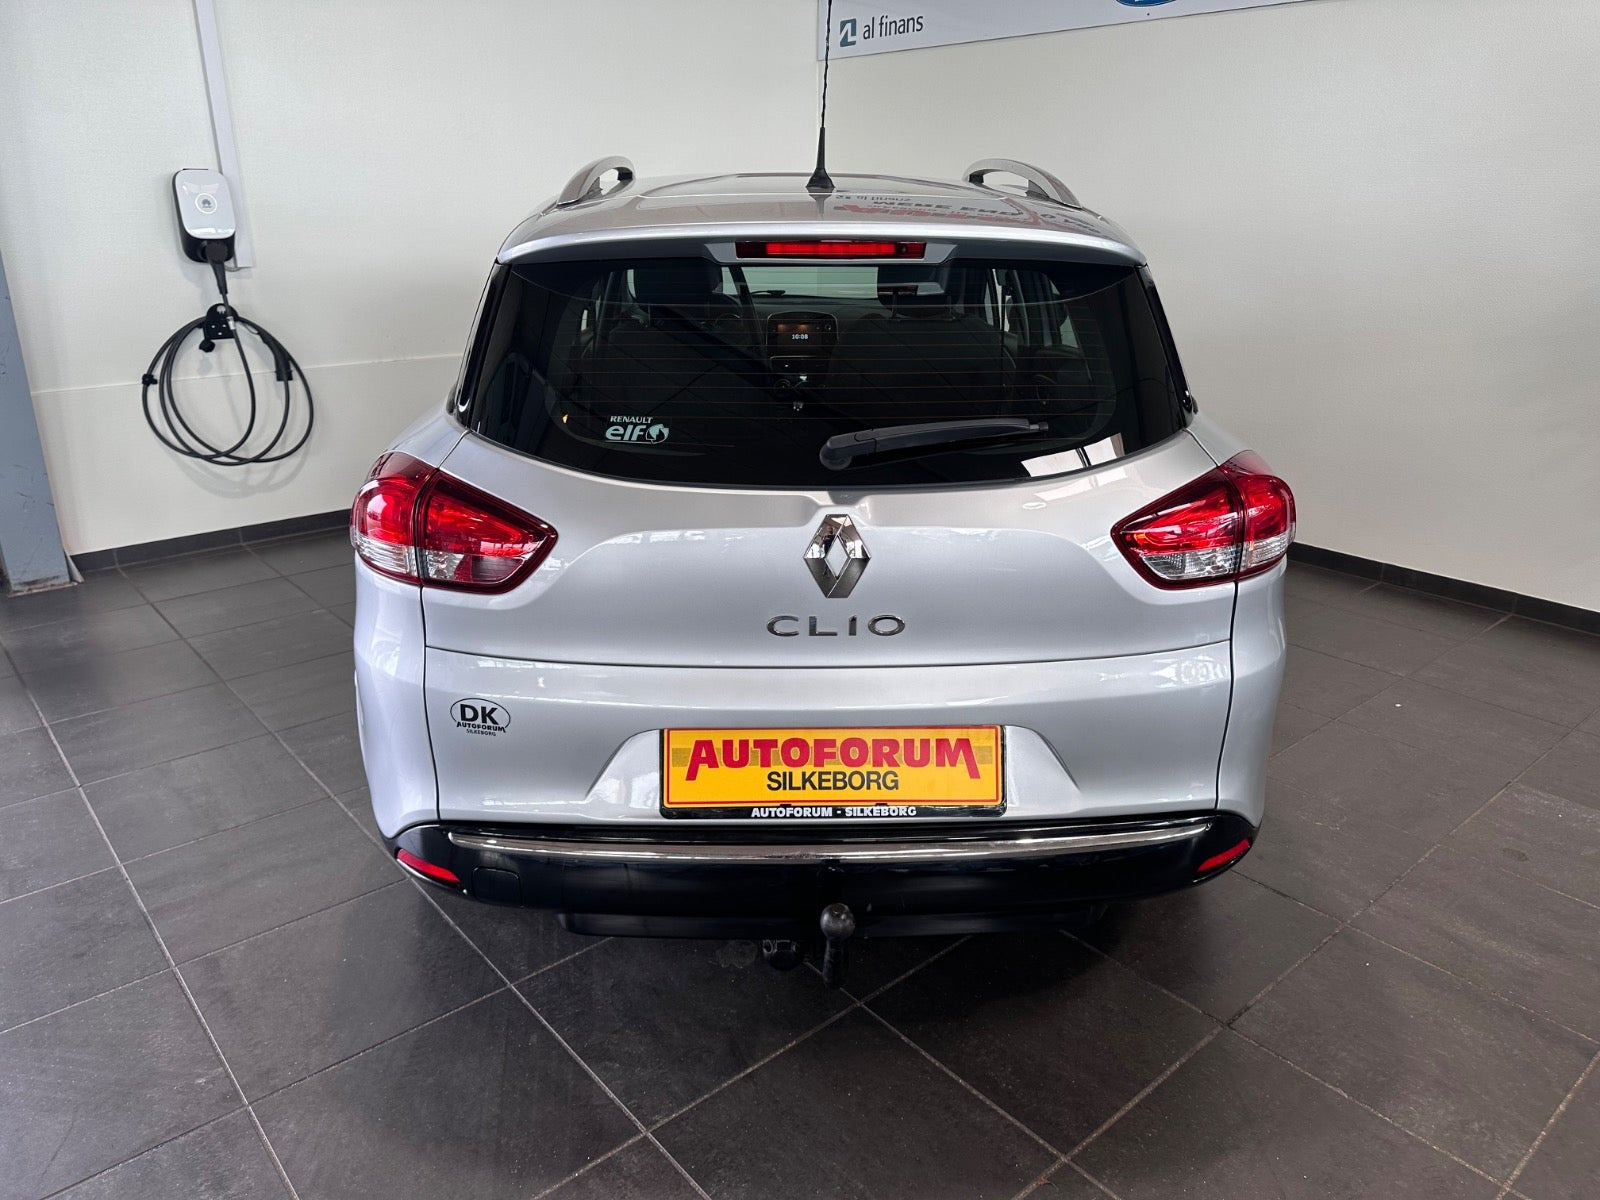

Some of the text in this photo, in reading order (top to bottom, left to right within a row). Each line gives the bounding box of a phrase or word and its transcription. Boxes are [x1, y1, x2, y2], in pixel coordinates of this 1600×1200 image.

[863, 15, 924, 40] al finans
[610, 415, 653, 424] RENAULT
[766, 614, 906, 637] CLIO
[460, 703, 499, 726] DK
[456, 721, 506, 733] AUTOFORUM
[685, 737, 981, 781] AUTOFORUM
[766, 770, 899, 791] SILKEBORG
[751, 807, 832, 818] AUTOFORUM
[845, 806, 917, 817] SILKEBORG
